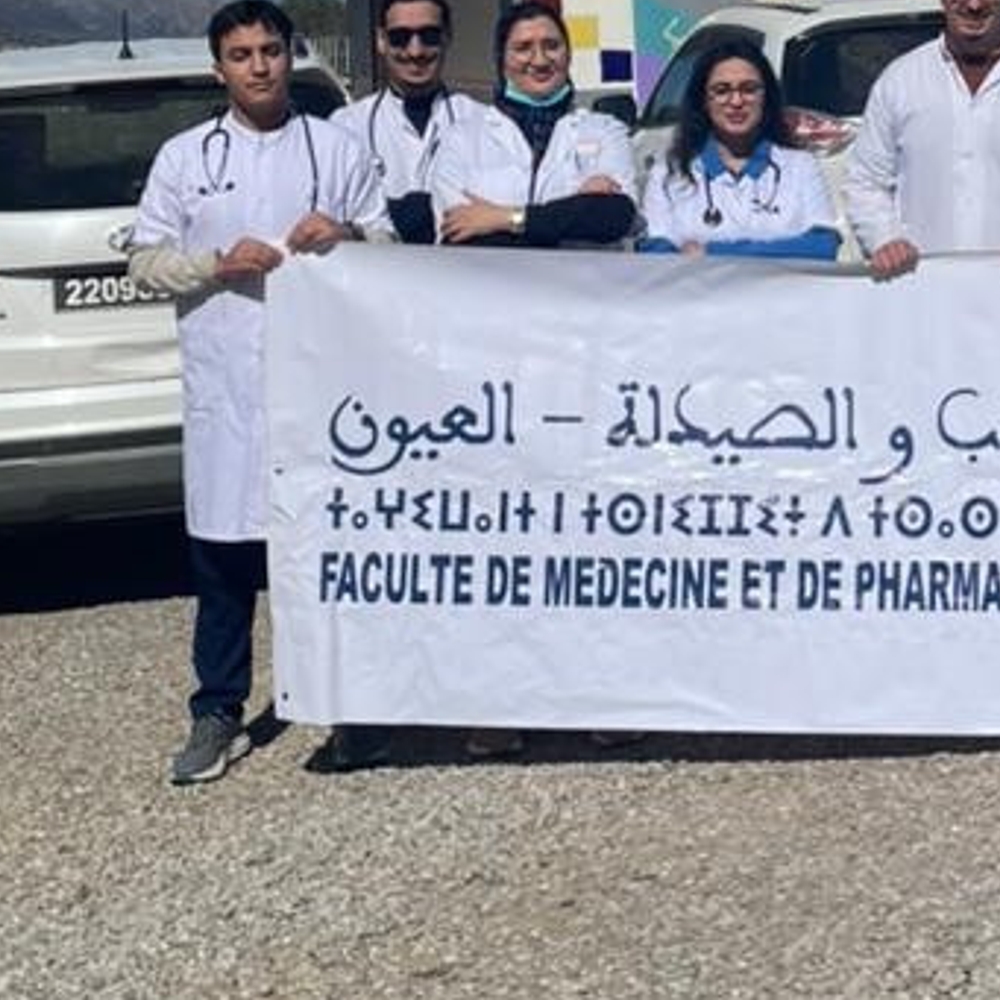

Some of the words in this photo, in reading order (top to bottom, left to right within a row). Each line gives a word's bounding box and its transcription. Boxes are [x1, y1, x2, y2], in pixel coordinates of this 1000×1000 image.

[63, 275, 172, 307] 2209
[328, 381, 516, 476] العيون
[606, 381, 857, 465] الصيدلة
[855, 426, 914, 485] و
[319, 551, 474, 606] FACULTE
[485, 554, 532, 607] DE
[543, 556, 729, 610] MEDECINE
[741, 559, 786, 611] ET
[797, 559, 843, 611] DE
